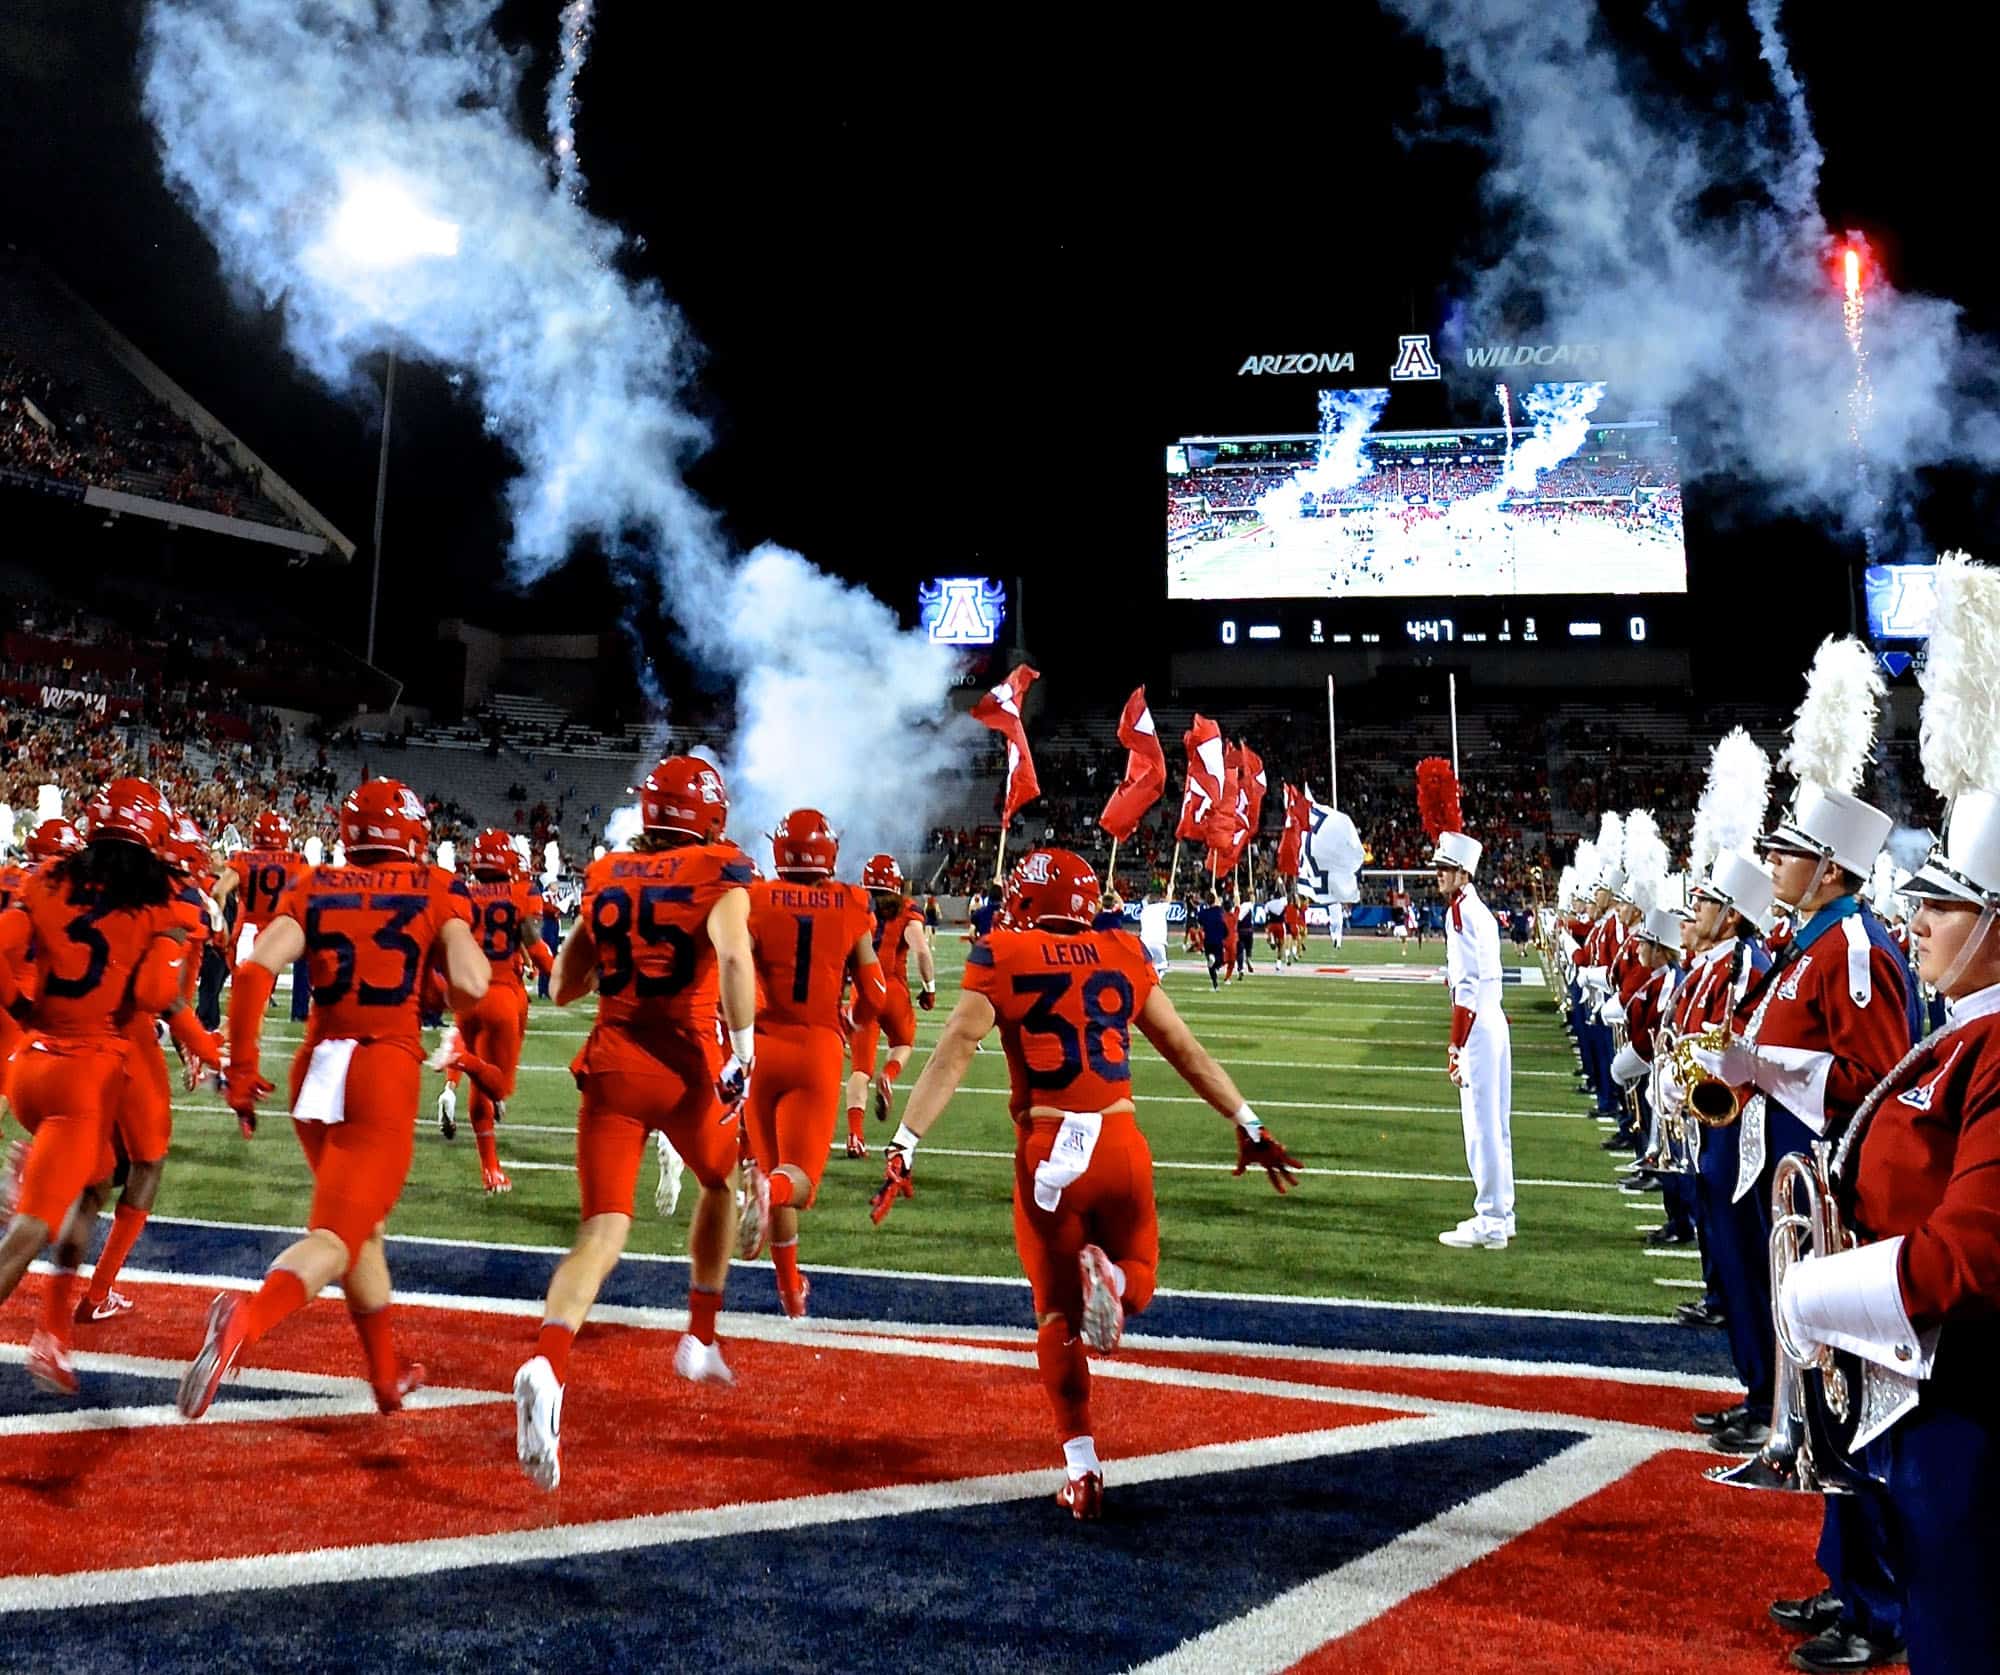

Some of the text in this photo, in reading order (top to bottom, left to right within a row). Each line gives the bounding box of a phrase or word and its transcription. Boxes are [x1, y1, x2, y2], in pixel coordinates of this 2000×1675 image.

[1238, 353, 1354, 375] ARIZONA
[1391, 335, 1441, 380] A
[1222, 621, 1235, 643] 0
[1313, 620, 1322, 634] 3
[1407, 620, 1453, 641] 4:47
[1526, 618, 1535, 632] 3
[1630, 617, 1645, 640] 0
[246, 864, 286, 912] 19
[771, 889, 830, 909] FIELDS
[305, 894, 428, 1005] 53
[592, 885, 695, 997] 85
[793, 915, 813, 1003] 1
[1041, 943, 1099, 966] LEON
[1011, 969, 1134, 1090] 38
